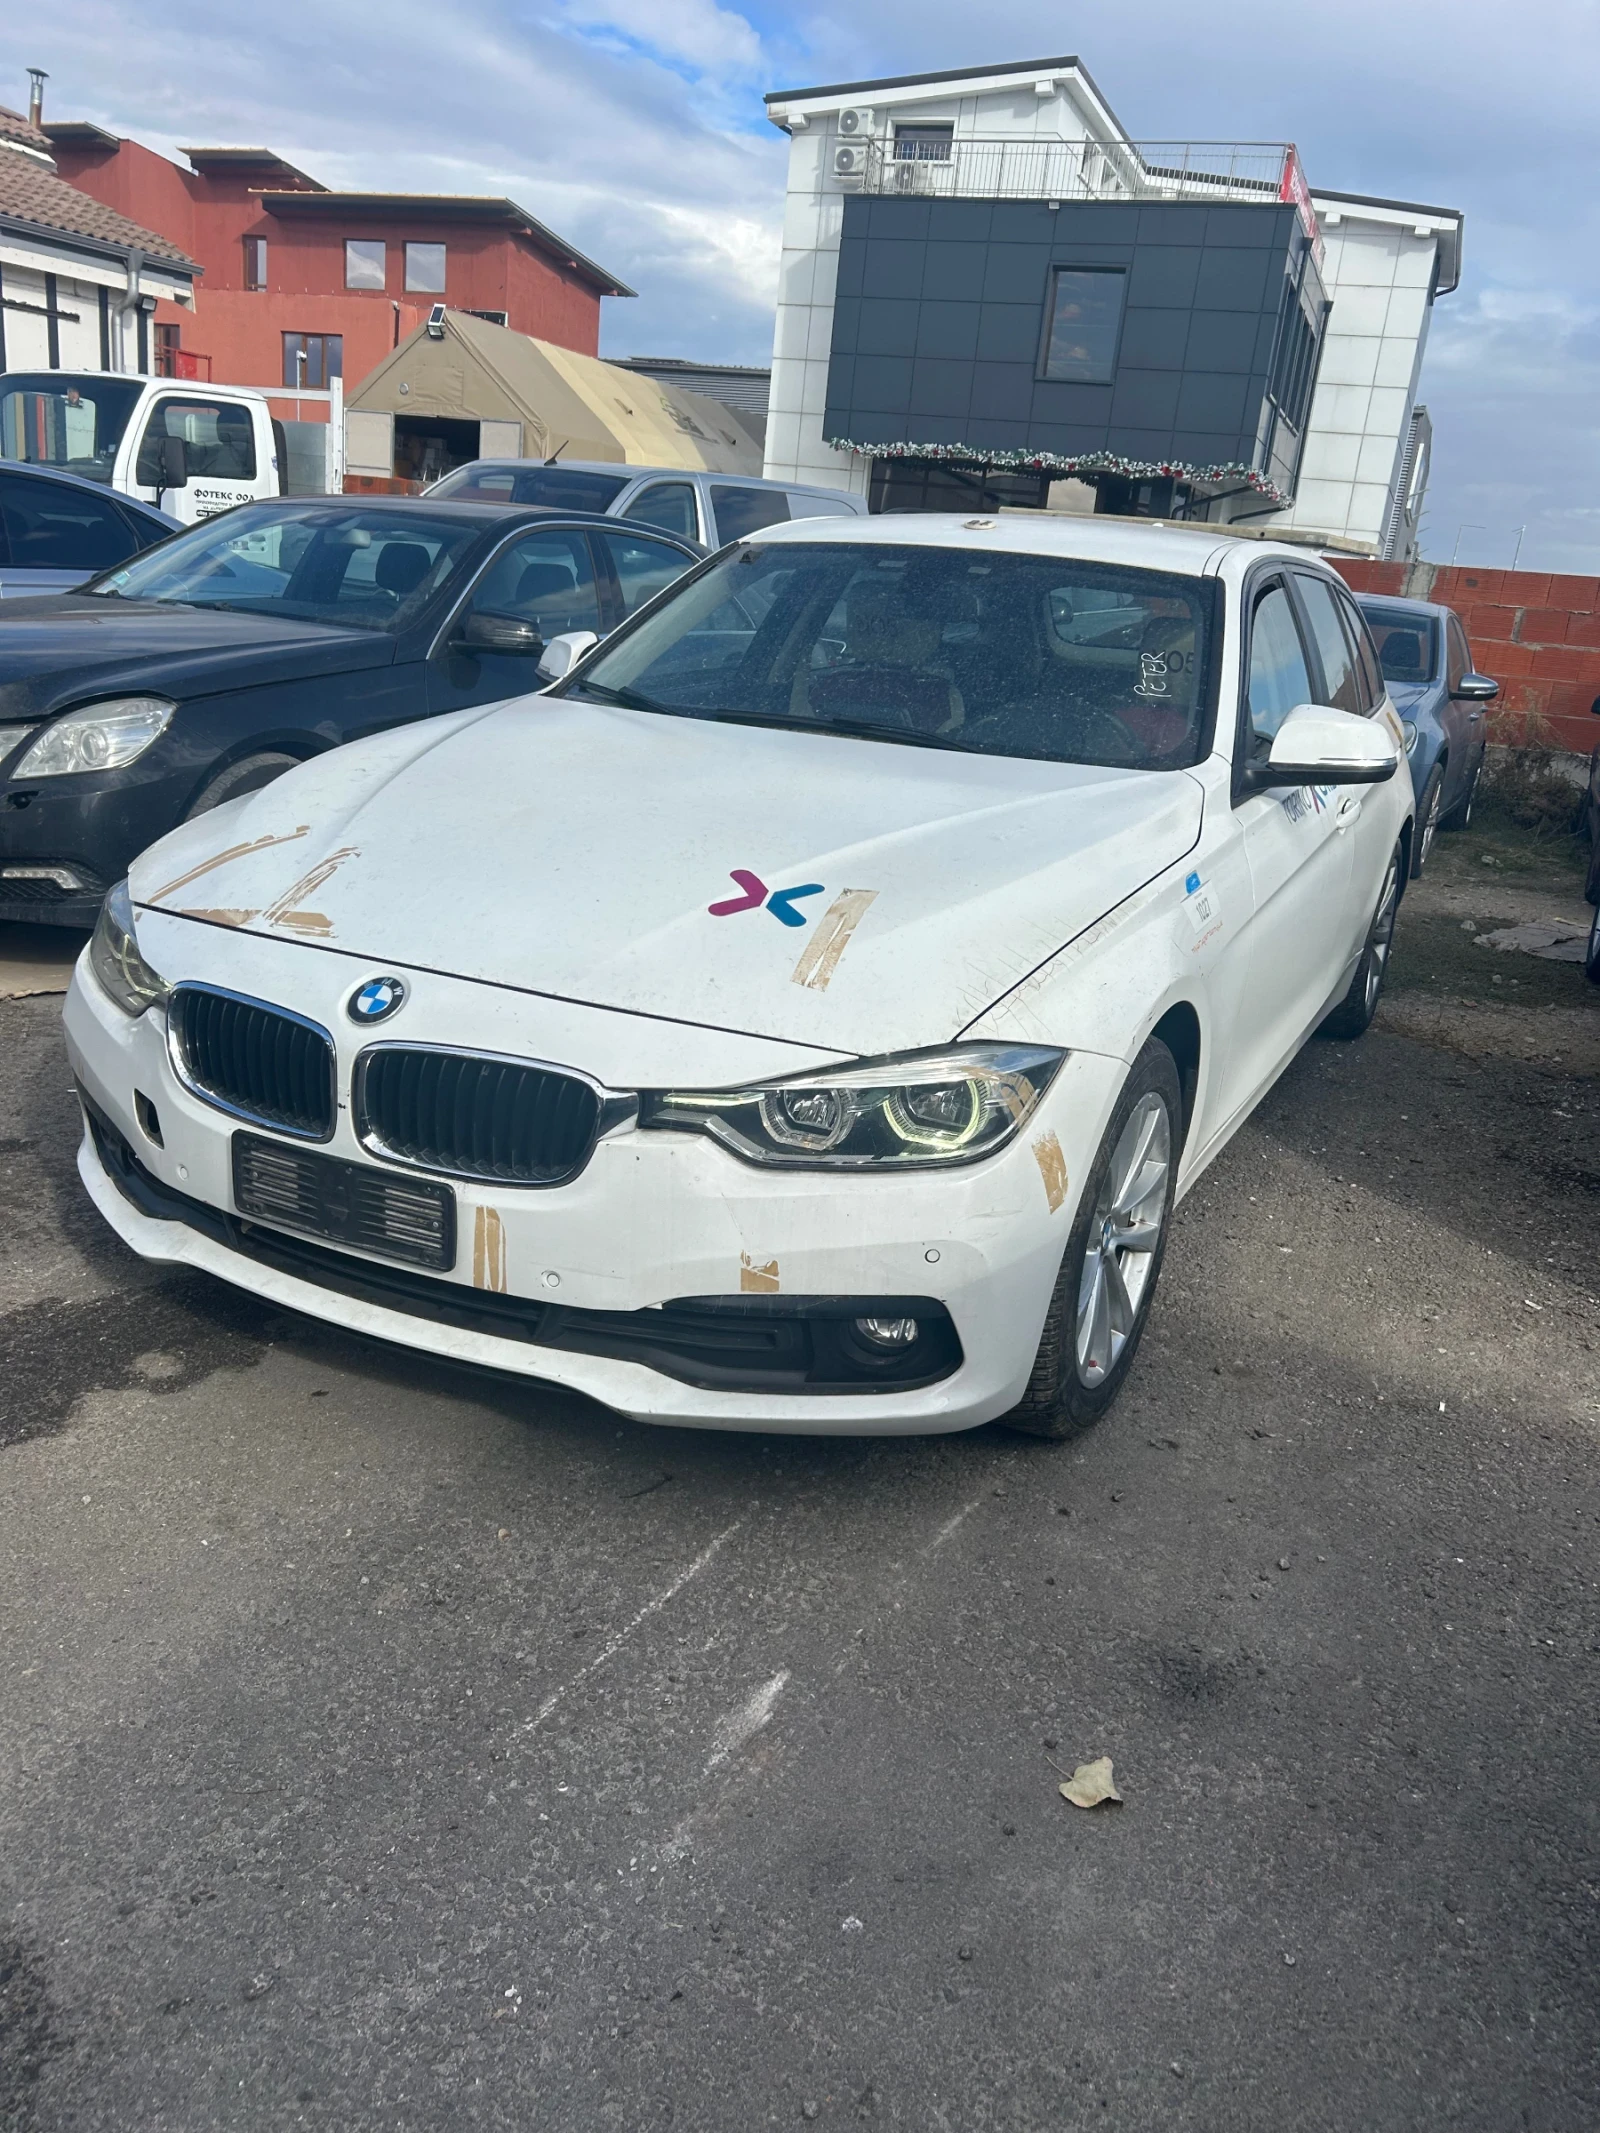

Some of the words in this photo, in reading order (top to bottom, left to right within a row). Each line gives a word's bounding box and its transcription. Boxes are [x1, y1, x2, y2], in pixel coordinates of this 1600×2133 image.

[194, 488, 233, 501] ФОТЕКС
[1195, 897, 1212, 922] 1027
[363, 978, 404, 996] BMW
